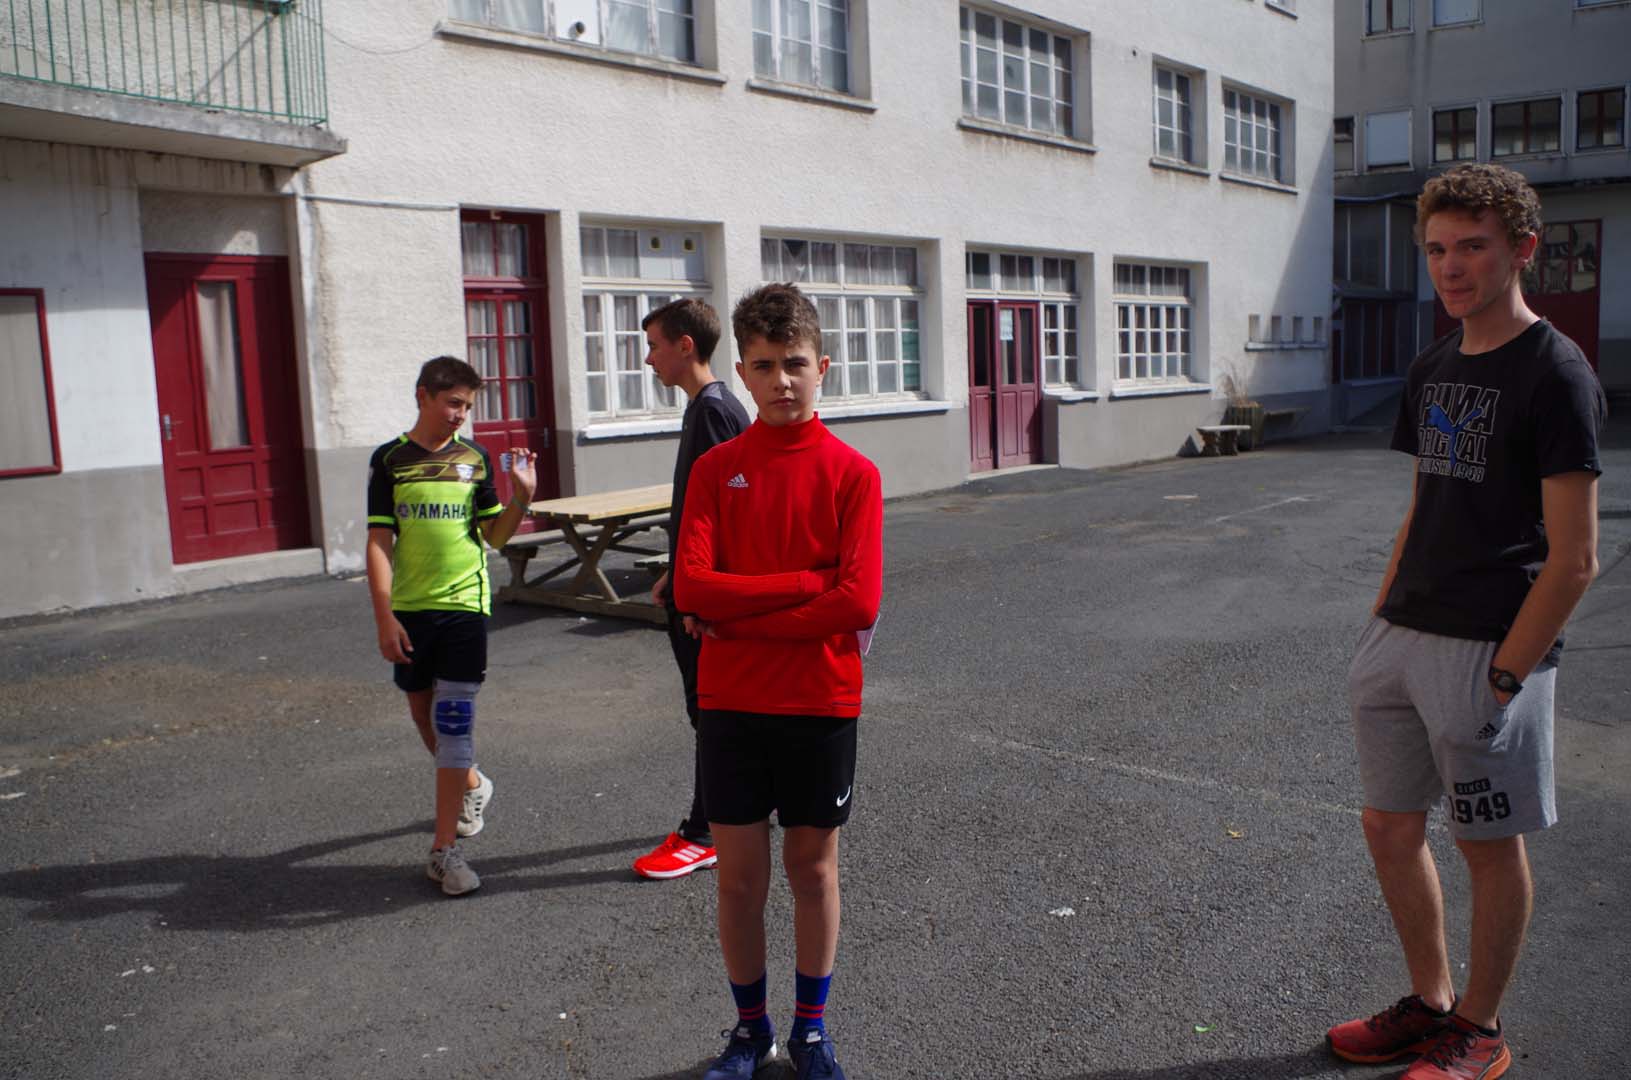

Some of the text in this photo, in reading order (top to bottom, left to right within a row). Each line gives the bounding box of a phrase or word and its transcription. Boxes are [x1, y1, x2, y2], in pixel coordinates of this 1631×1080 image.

[1419, 382, 1500, 435] PUMA
[1417, 427, 1487, 465] ORIGNAL
[410, 503, 467, 520] YAMAHA
[1456, 780, 1489, 794] SINCE
